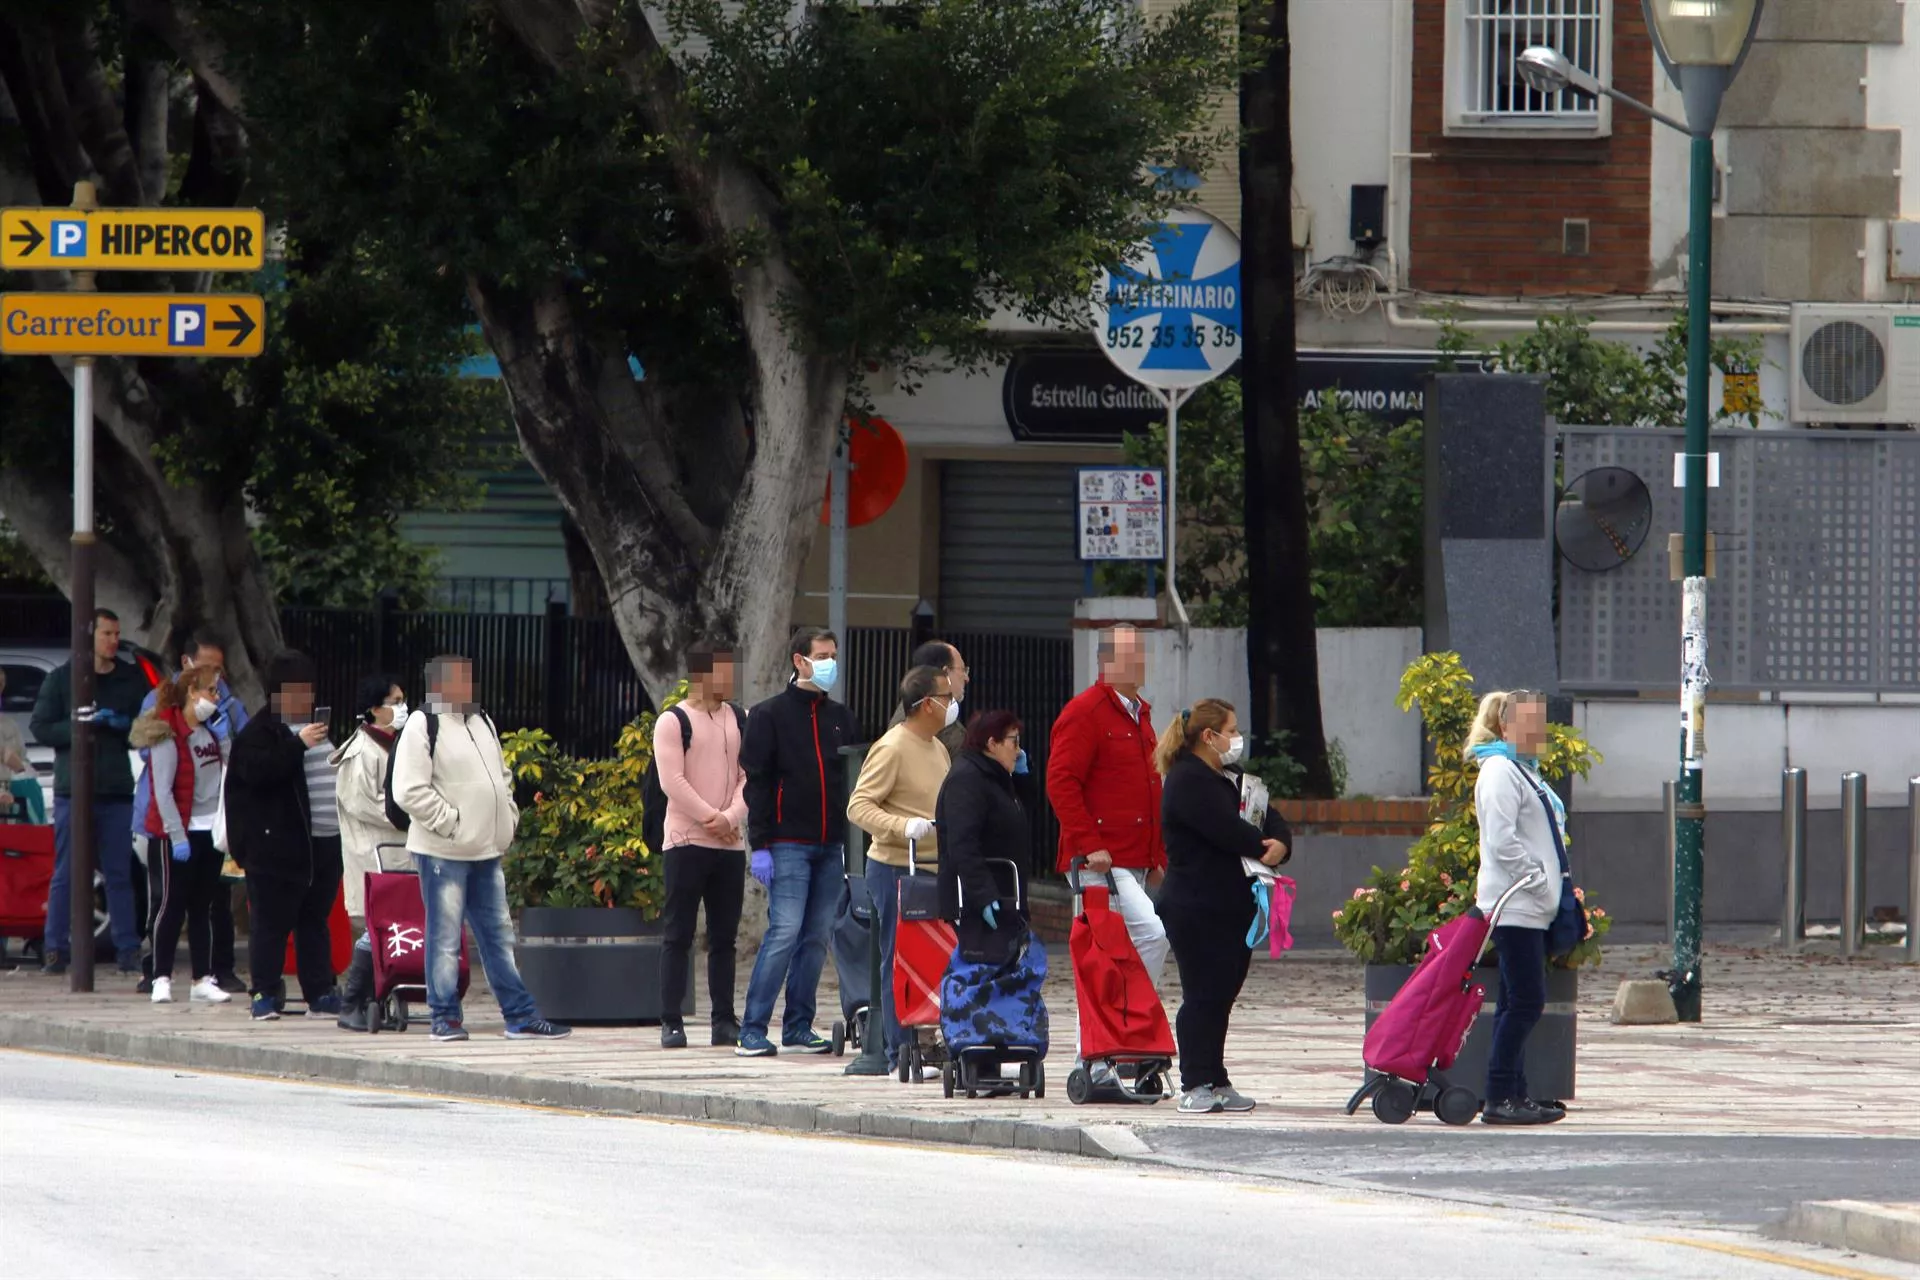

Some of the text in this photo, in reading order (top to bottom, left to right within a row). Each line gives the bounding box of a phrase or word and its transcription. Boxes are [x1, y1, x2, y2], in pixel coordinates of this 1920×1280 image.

[58, 223, 254, 257] P HIPERCOR
[1117, 283, 1236, 309] VETERINARIO
[7, 309, 201, 343] Carrefour P
[1107, 325, 1236, 348] 952 35 35 35
[1031, 383, 1098, 408] Estrella
